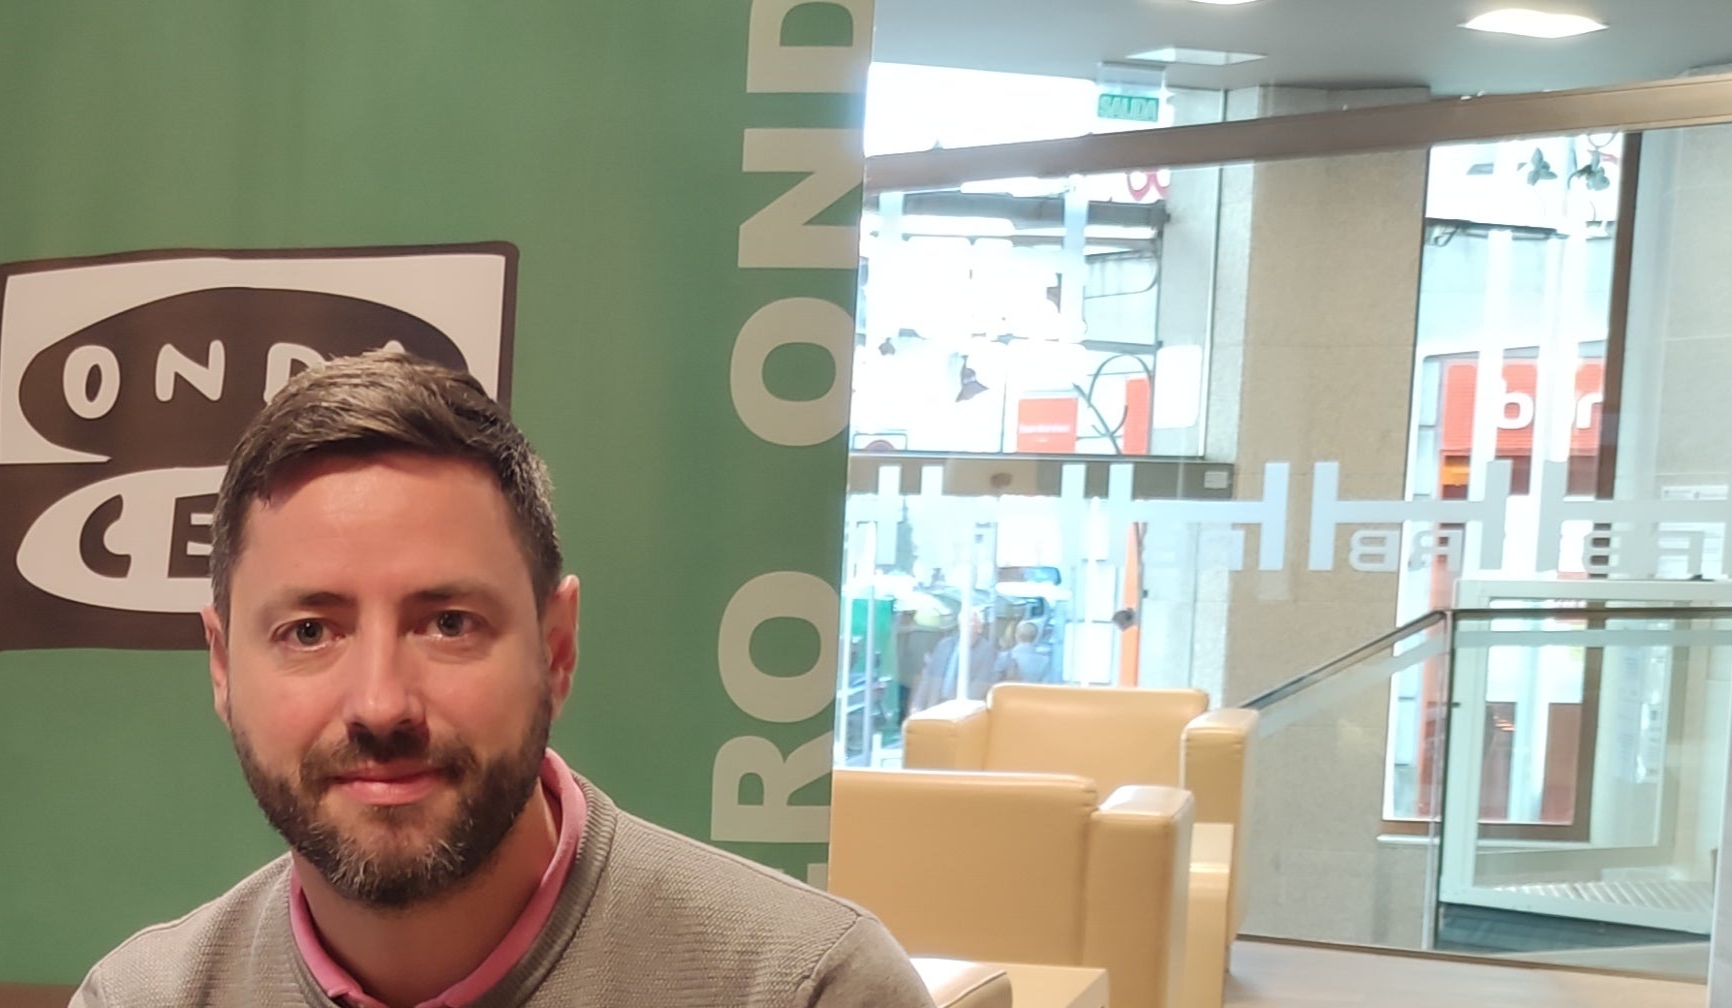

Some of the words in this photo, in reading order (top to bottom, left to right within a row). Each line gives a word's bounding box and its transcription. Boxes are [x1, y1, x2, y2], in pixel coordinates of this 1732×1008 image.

[1099, 95, 1158, 120] SALIDA
[730, 0, 874, 446] OND
[63, 339, 406, 419] OND
[80, 492, 219, 579] CE
[711, 571, 841, 892] RO
